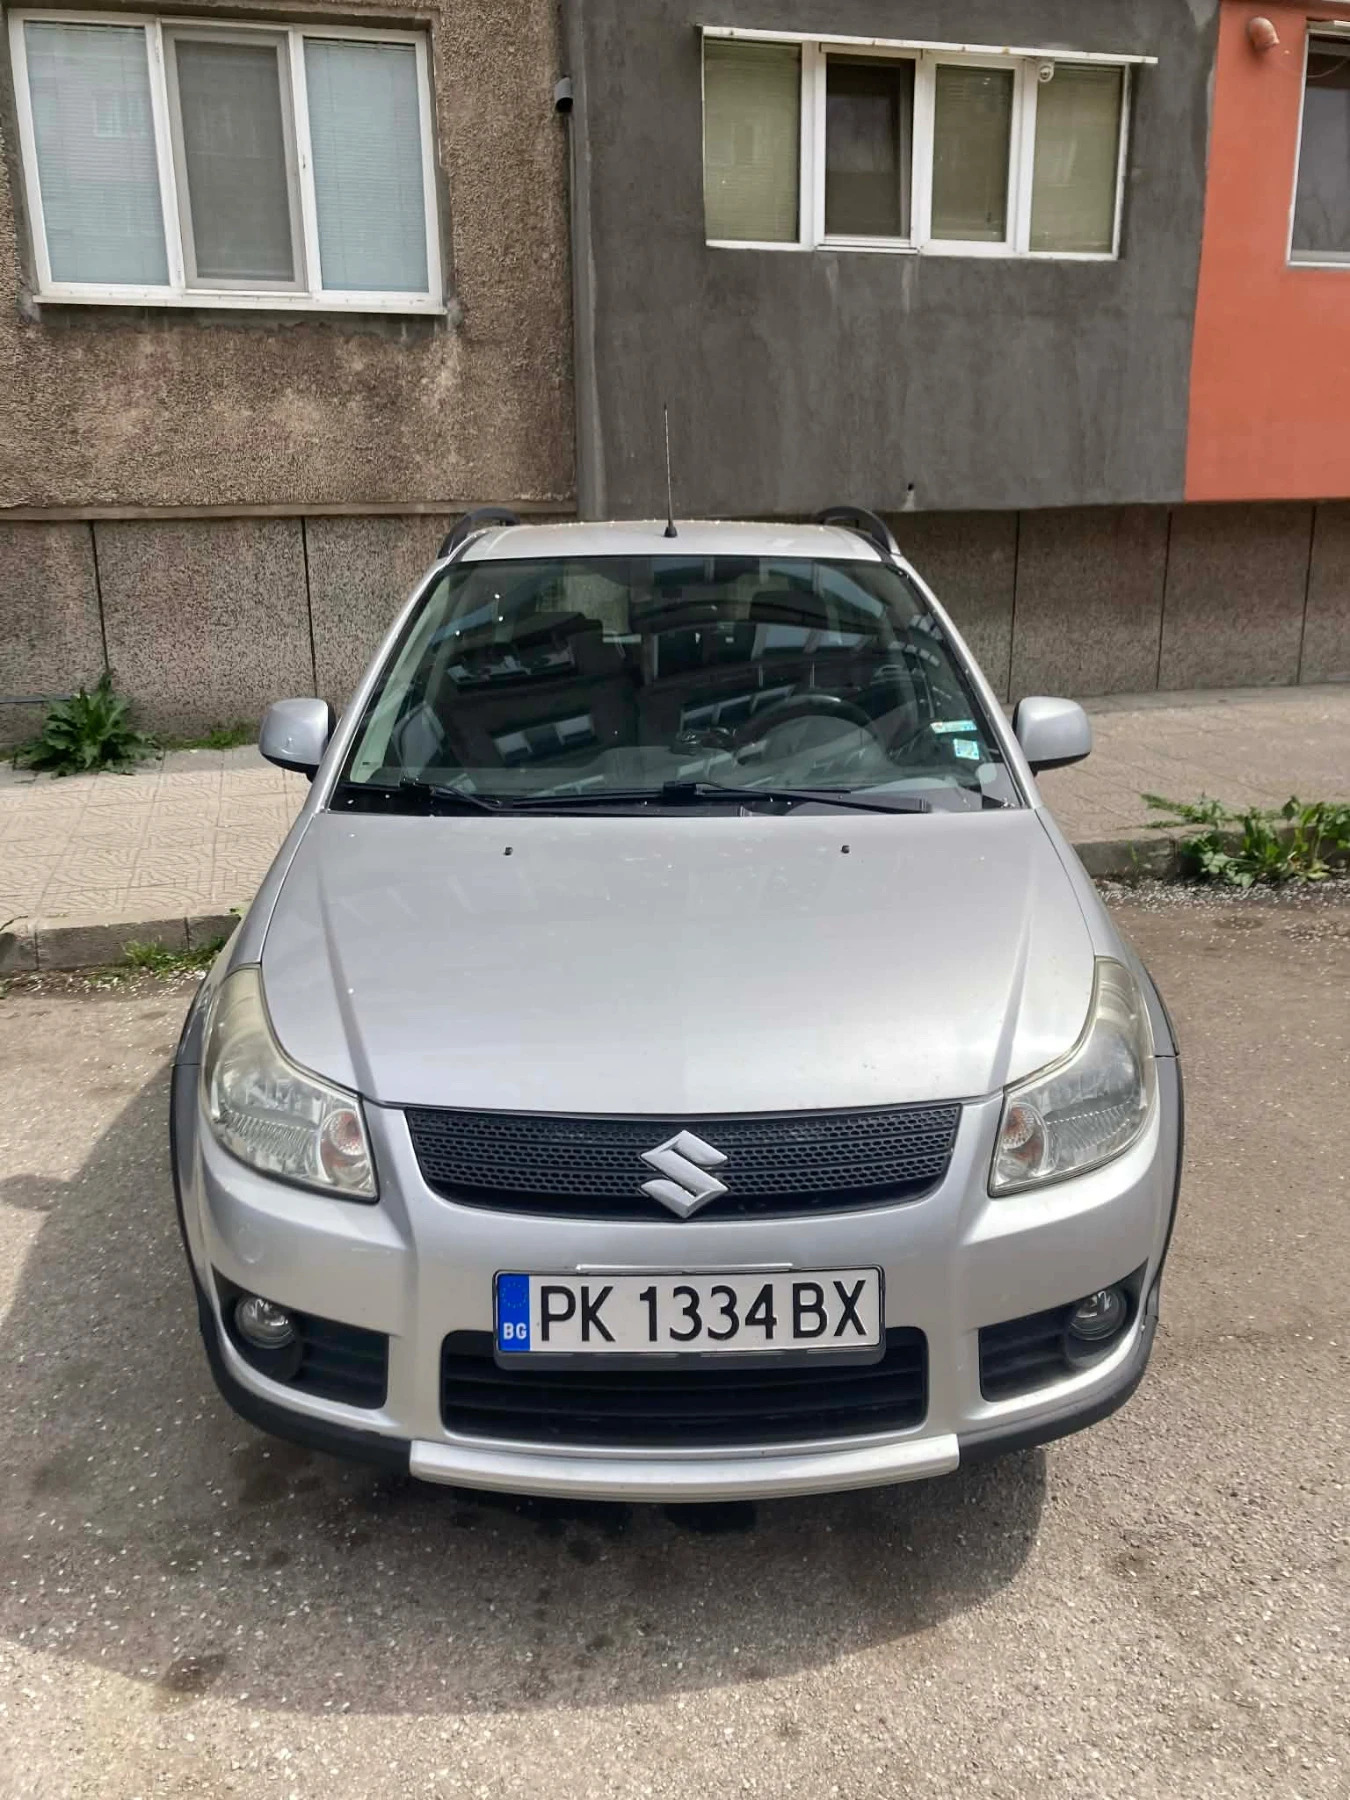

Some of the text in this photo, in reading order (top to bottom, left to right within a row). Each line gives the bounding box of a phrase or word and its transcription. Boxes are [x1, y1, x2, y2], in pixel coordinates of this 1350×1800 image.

[540, 1279, 867, 1342] PK 1334 BX
[502, 1322, 528, 1341] BG
